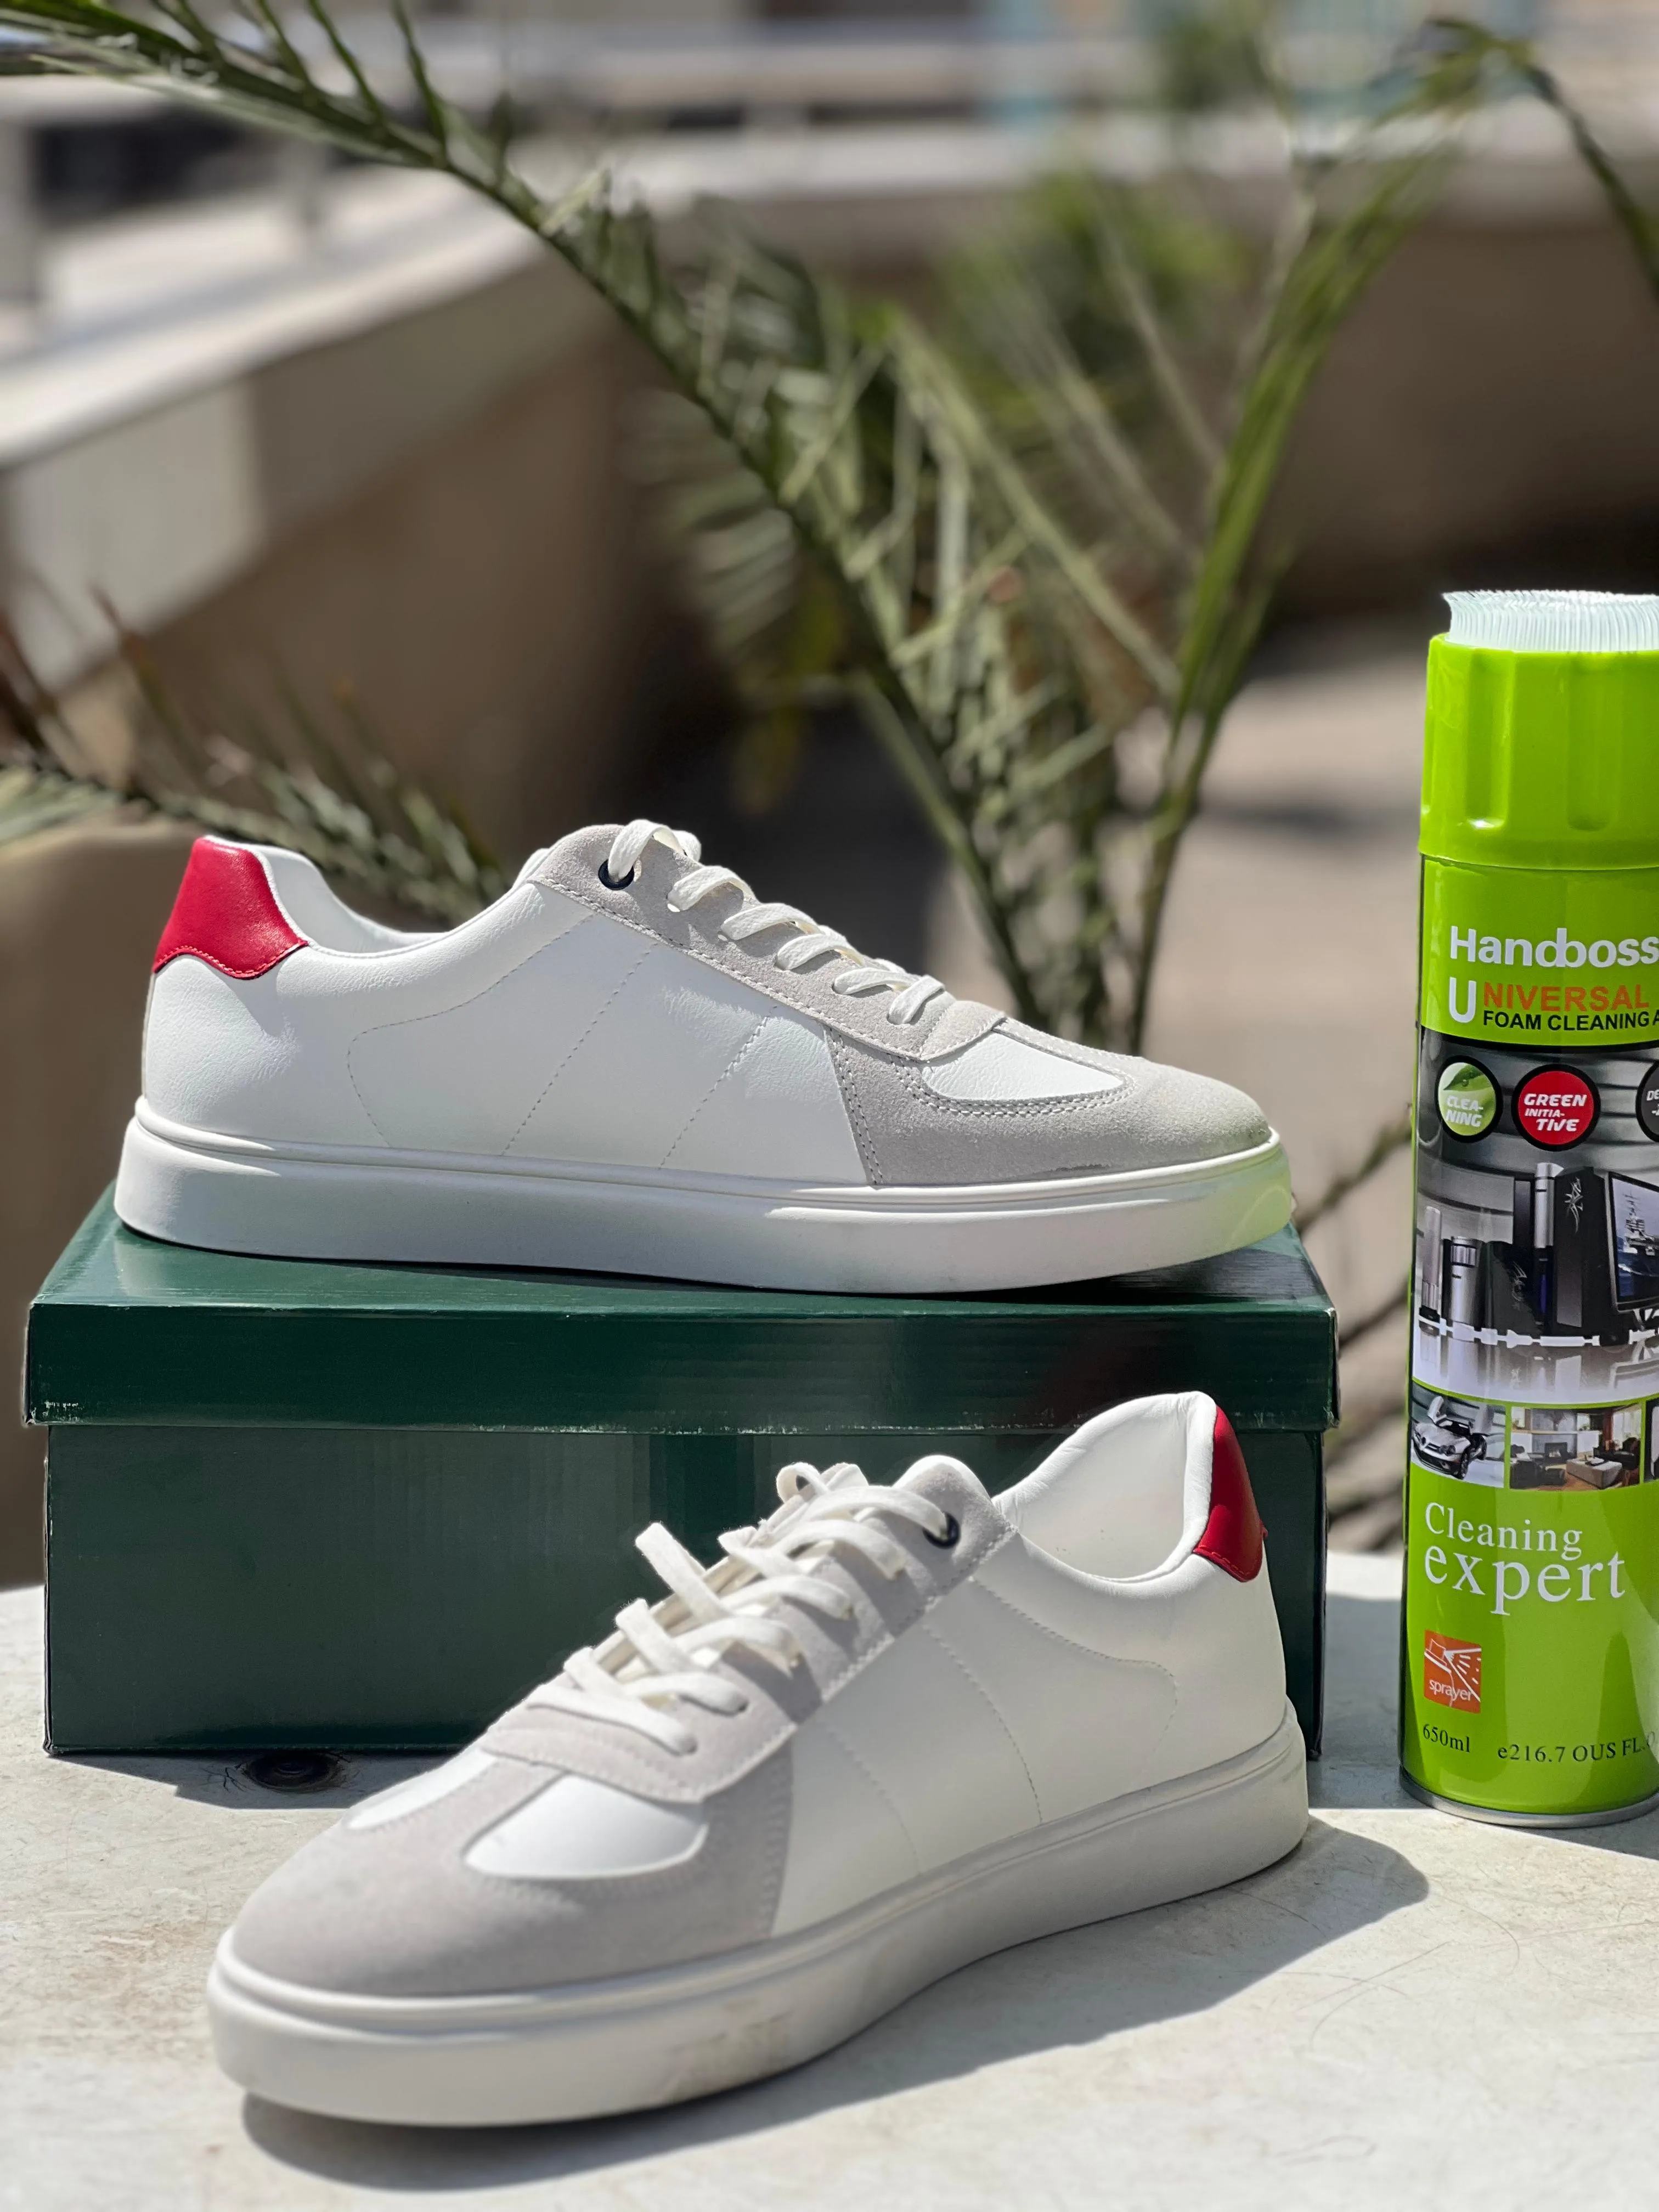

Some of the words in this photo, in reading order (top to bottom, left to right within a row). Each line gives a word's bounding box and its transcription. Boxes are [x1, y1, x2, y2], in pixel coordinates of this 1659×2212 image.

[1450, 926, 1659, 968] Handboss
[1483, 1010, 1541, 1030] FOAM
[1547, 1011, 1650, 1031] CLEANING
[1446, 1095, 1484, 1112] CLEA-
[1523, 1093, 1587, 1107] GREEN
[1445, 1109, 1482, 1128] NING
[1524, 1108, 1565, 1118] INITIA-
[1536, 1119, 1580, 1132] TIVE
[1425, 1502, 1583, 1561] Cleaning
[1425, 1545, 1626, 1616] expert
[1429, 1678, 1474, 1702] sprayer
[1423, 1723, 1471, 1753] 650ml
